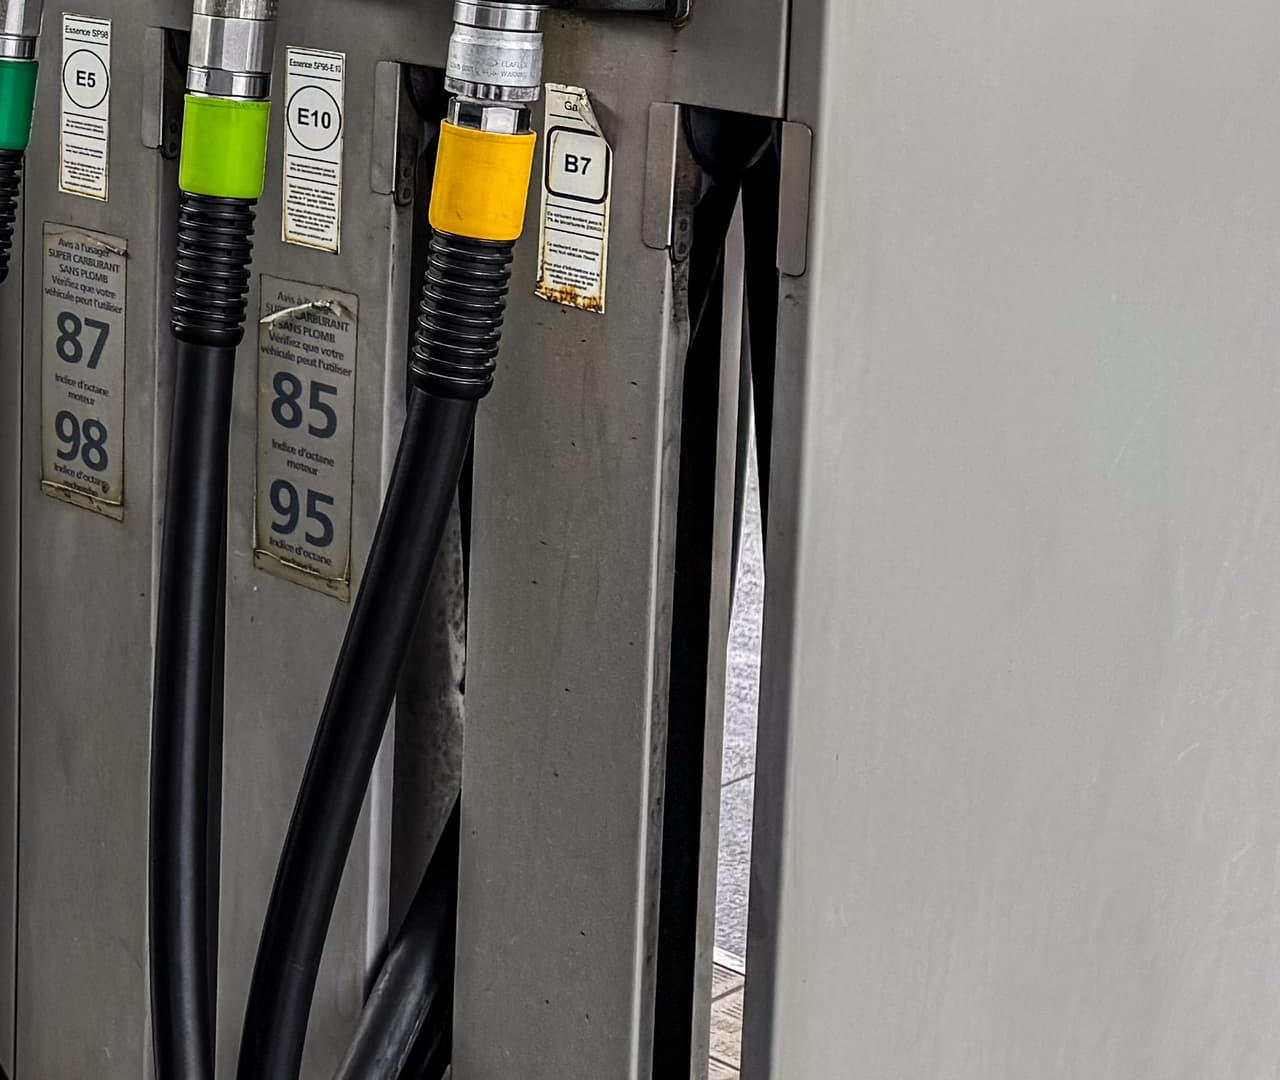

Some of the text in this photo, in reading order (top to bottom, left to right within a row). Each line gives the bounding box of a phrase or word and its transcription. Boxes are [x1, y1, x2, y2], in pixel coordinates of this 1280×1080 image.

[64, 25, 109, 39] Essence SP98
[289, 58, 313, 69] Essence
[76, 69, 96, 88] E5
[297, 107, 332, 129] E10
[564, 153, 592, 176] B7
[58, 238, 74, 250] Avis
[48, 248, 121, 273] SUPER CARBURANT
[58, 263, 109, 284] SANS PLOMB
[80, 283, 95, 294] que
[95, 287, 117, 299] votre
[75, 294, 93, 307] peut
[56, 311, 110, 370] 87
[303, 328, 336, 344] PLOMB
[302, 341, 320, 354] que
[320, 347, 345, 361] votre
[296, 355, 318, 368] peut
[55, 372, 77, 387] Indice
[271, 370, 338, 439] 85
[55, 409, 109, 472] 98
[271, 438, 336, 468] Indice d'octane
[53, 461, 76, 477] Indice
[286, 459, 319, 476] moteur
[269, 478, 335, 548] 95
[268, 536, 295, 553] Indice
